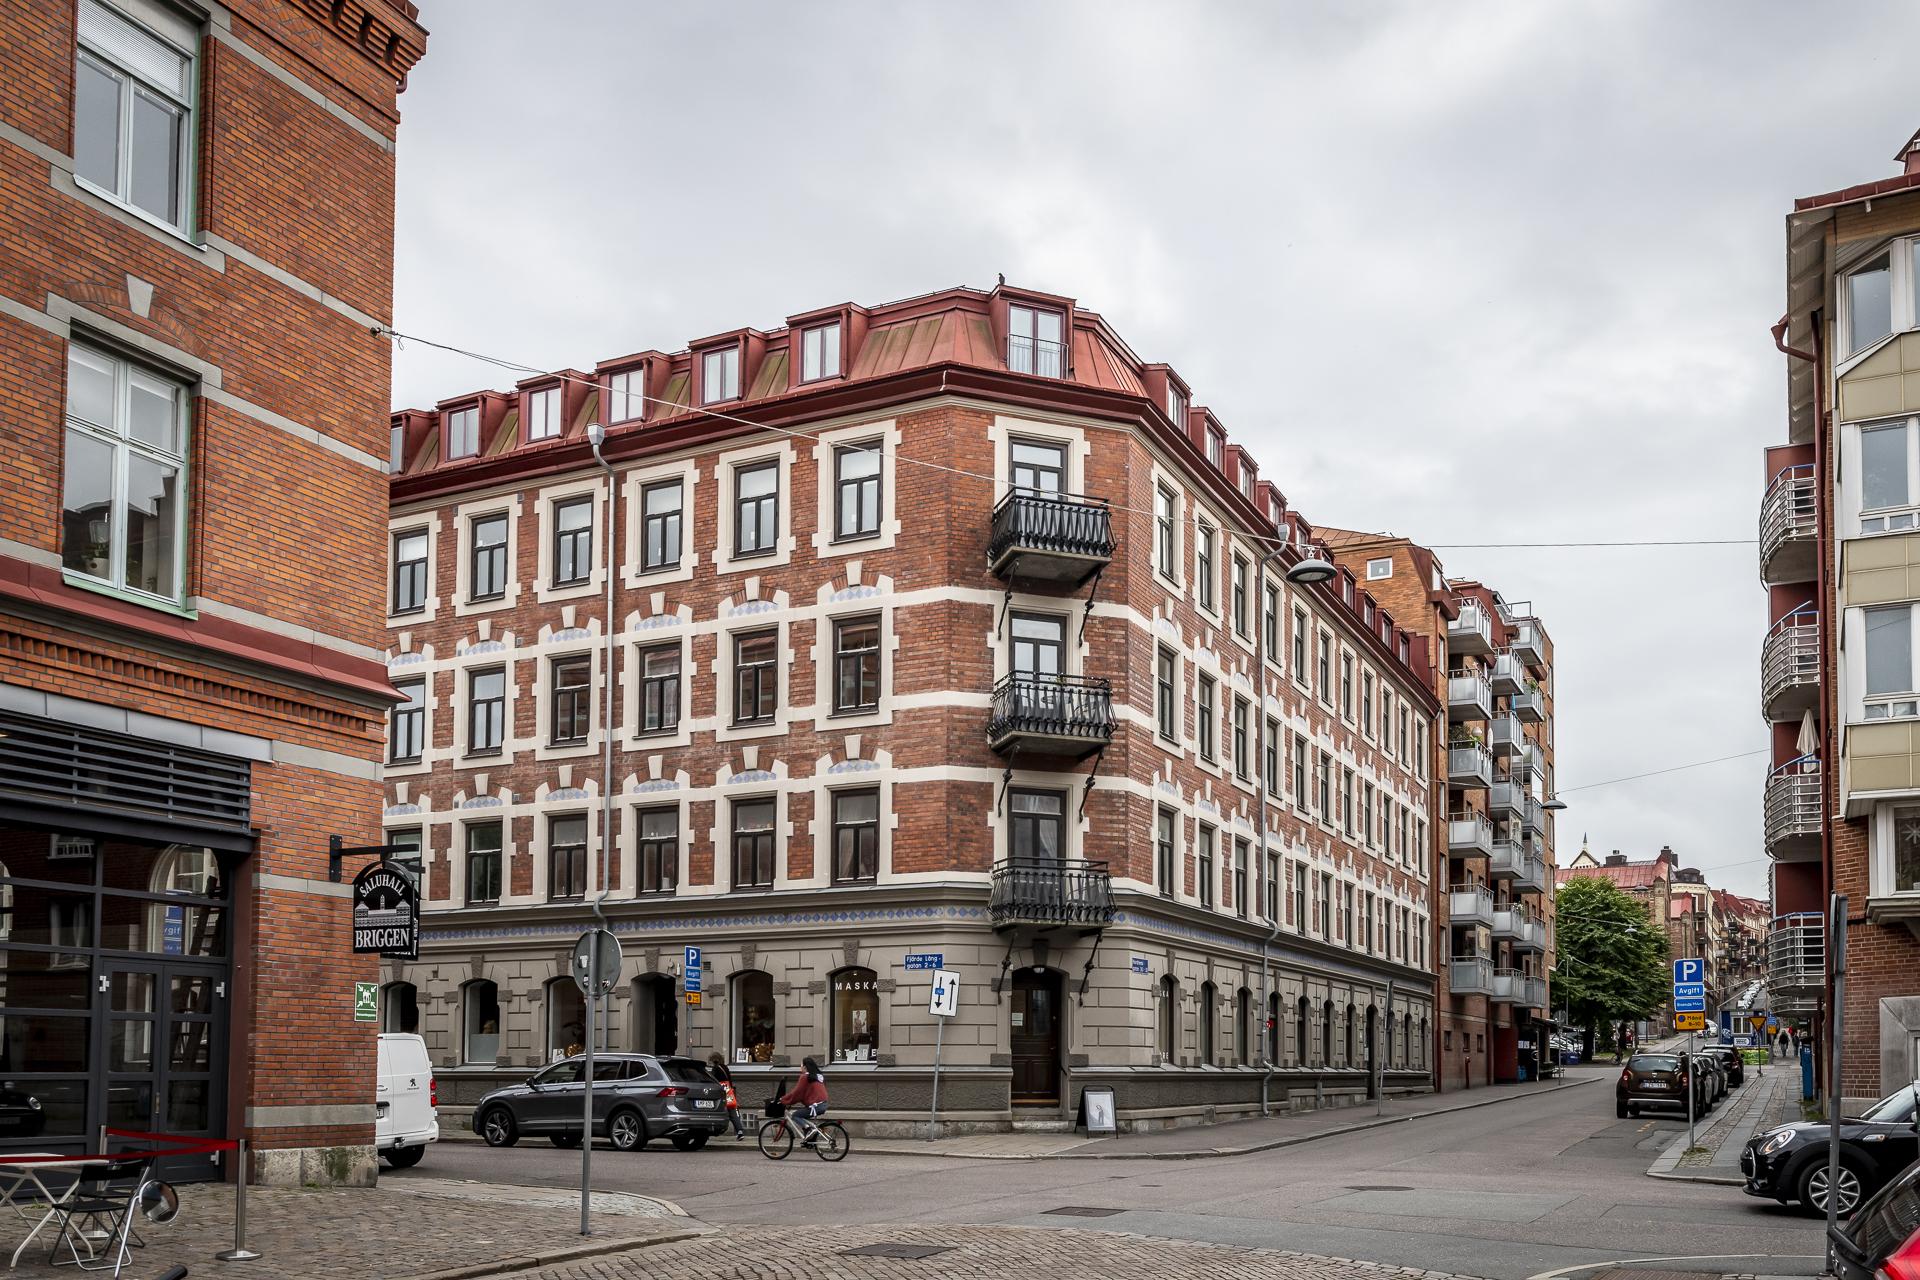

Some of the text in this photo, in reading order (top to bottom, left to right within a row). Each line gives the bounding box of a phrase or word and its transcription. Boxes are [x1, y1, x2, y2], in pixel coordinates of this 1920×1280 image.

[359, 874, 406, 898] SALUHALL
[355, 928, 410, 948] BRIGGEN
[689, 949, 697, 965] P
[1683, 961, 1697, 981] P
[835, 981, 878, 991] MASKA
[1678, 987, 1700, 995] Avgift
